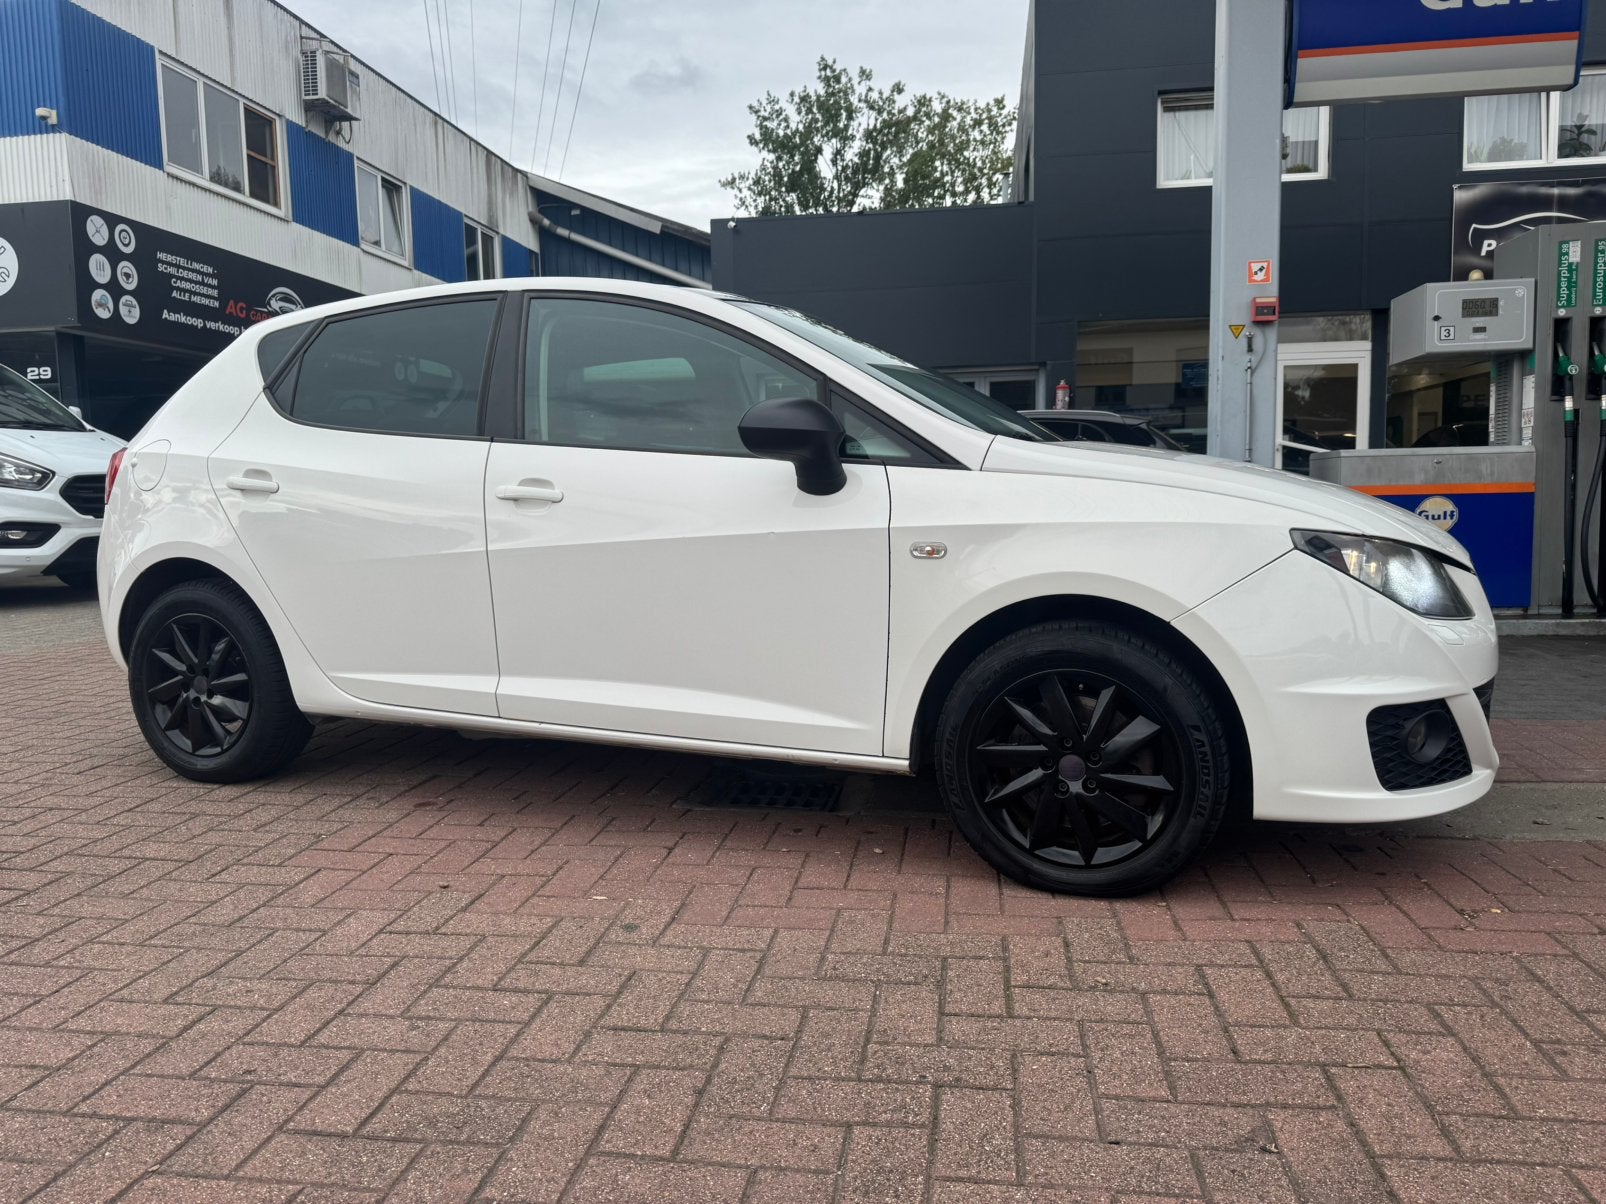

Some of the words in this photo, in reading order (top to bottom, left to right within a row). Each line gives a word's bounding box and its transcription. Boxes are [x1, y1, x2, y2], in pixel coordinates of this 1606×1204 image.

[1562, 243, 1569, 252] 98
[1598, 240, 1606, 250] 95
[157, 251, 213, 274] HERSTELLINGEN
[158, 263, 202, 281] SCHILDEREN
[203, 275, 218, 286] VAN
[1558, 256, 1569, 306] Superplus
[1593, 253, 1606, 305] Eurosuper
[171, 278, 219, 298] CARROSSERIE
[172, 290, 190, 301] ALLE
[191, 296, 219, 308] MERKEN
[226, 299, 247, 318] AG
[162, 309, 204, 329] Aankoop
[205, 321, 240, 336] verkoop
[1444, 328, 1451, 338] 3
[27, 367, 51, 379] 29
[1418, 510, 1456, 520] Gulf
